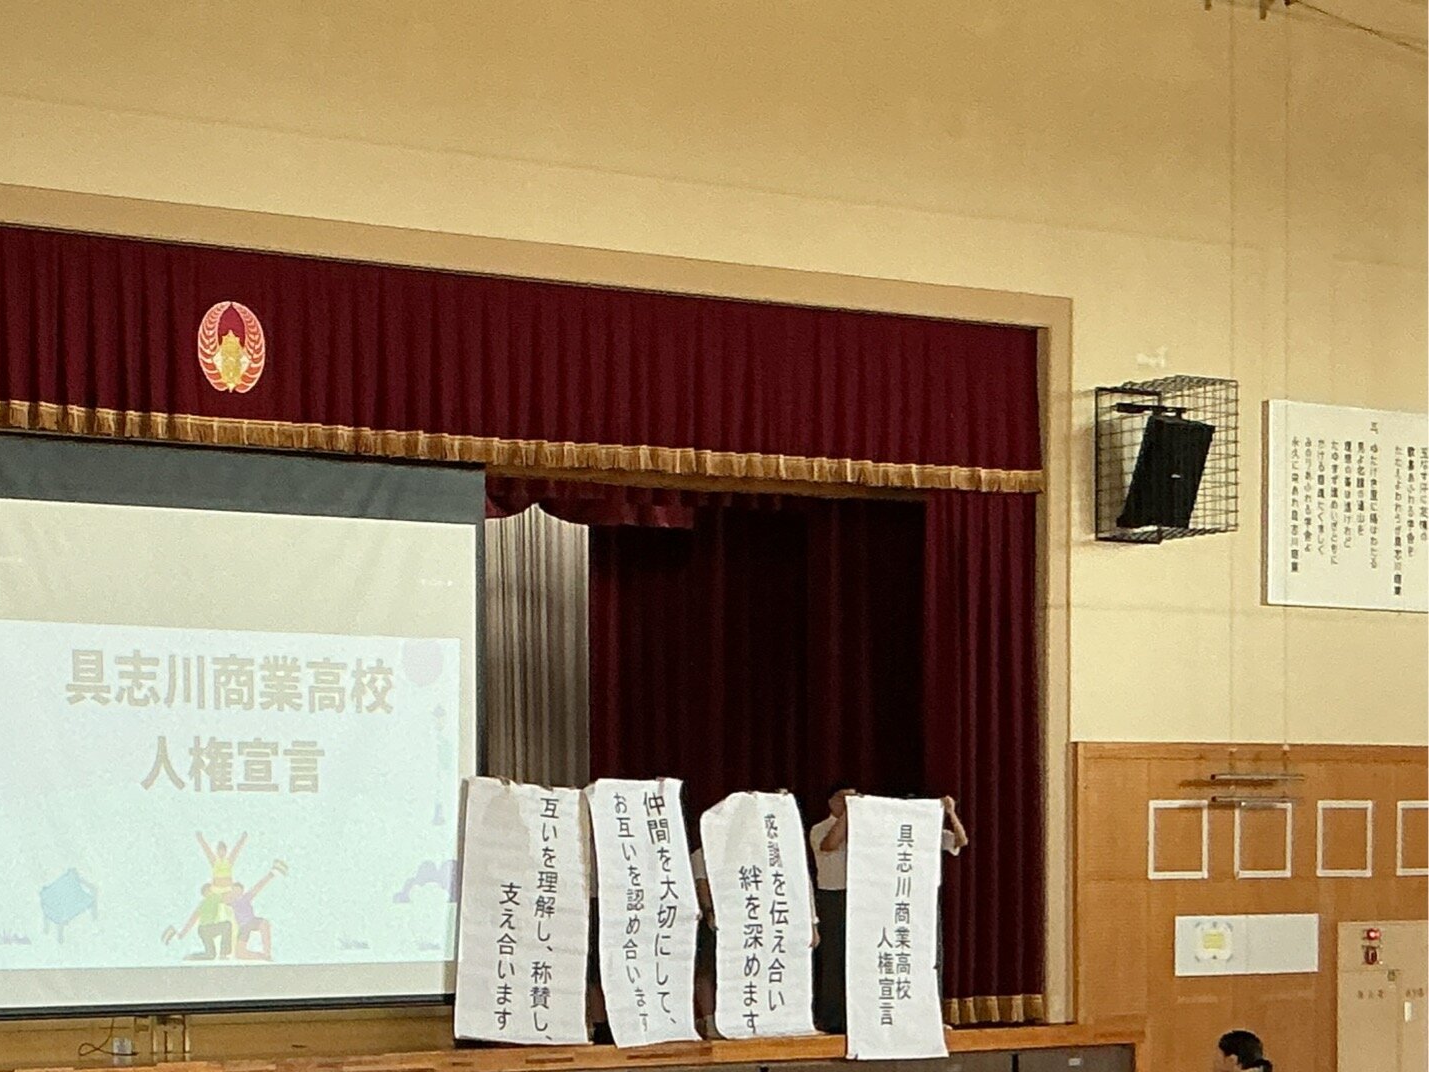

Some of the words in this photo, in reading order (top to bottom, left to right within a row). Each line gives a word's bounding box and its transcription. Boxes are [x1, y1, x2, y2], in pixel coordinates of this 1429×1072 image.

[65, 649, 395, 714] 具志川商業高校
[141, 735, 326, 794] 人権宣言
[495, 882, 521, 1030] 支え合います
[642, 790, 678, 1025] 仲間を大切にして、
[739, 865, 763, 1034] 絆を深めます
[878, 927, 894, 1025] 人権宣言
[893, 825, 914, 999] 具志川商業高校
